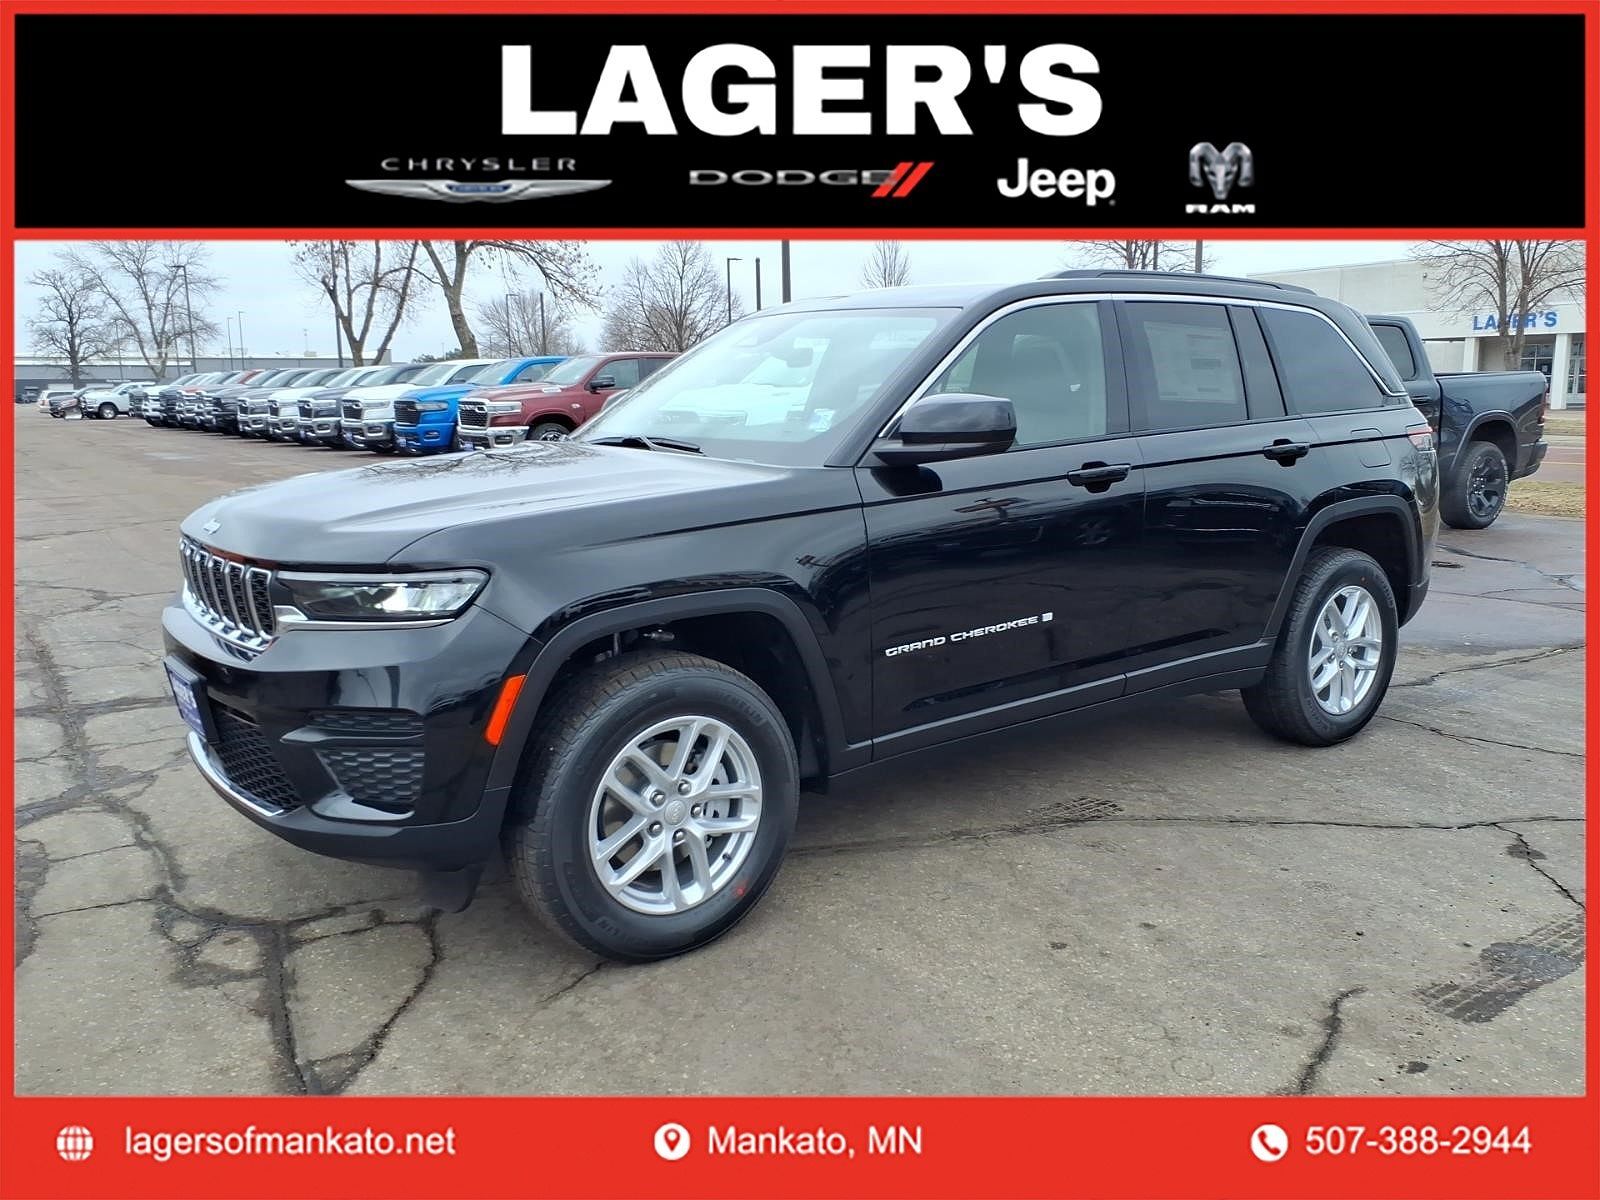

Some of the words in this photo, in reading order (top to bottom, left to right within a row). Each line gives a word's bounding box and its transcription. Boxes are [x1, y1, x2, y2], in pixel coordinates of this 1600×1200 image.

[1472, 311, 1558, 331] LAER'S
[885, 636, 946, 657] GRAND
[950, 615, 1039, 642] CHEROKEE
